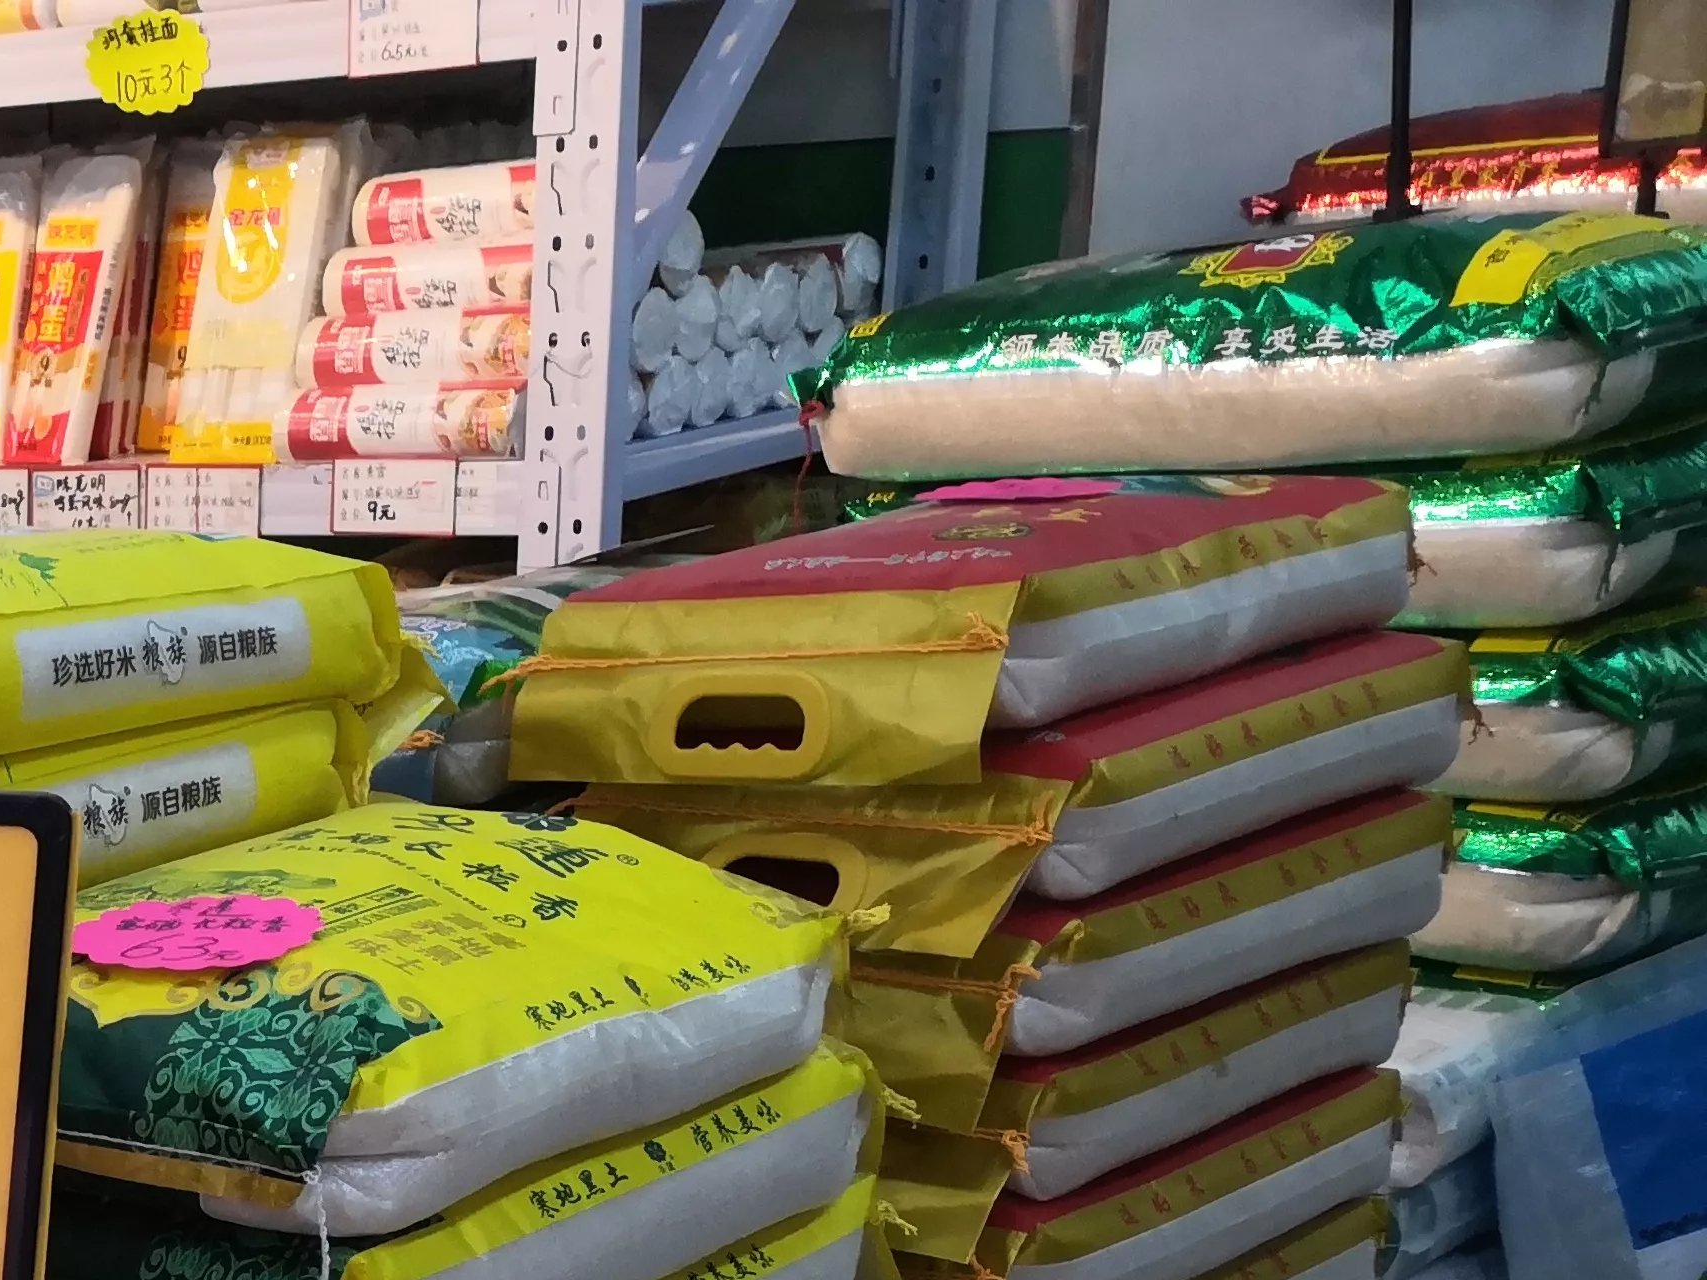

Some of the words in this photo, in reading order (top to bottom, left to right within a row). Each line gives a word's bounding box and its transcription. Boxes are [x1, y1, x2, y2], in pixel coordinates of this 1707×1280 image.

[1216, 326, 1399, 356] 享受生活
[367, 500, 396, 521] 9元
[51, 646, 137, 688] 珍选好米
[197, 626, 278, 665] 源自粮族
[141, 776, 222, 823] 源自粮族
[524, 987, 617, 1031] 寒地黑土
[528, 1162, 629, 1218] 寒地黑土
[690, 1097, 781, 1153] 营养美味
